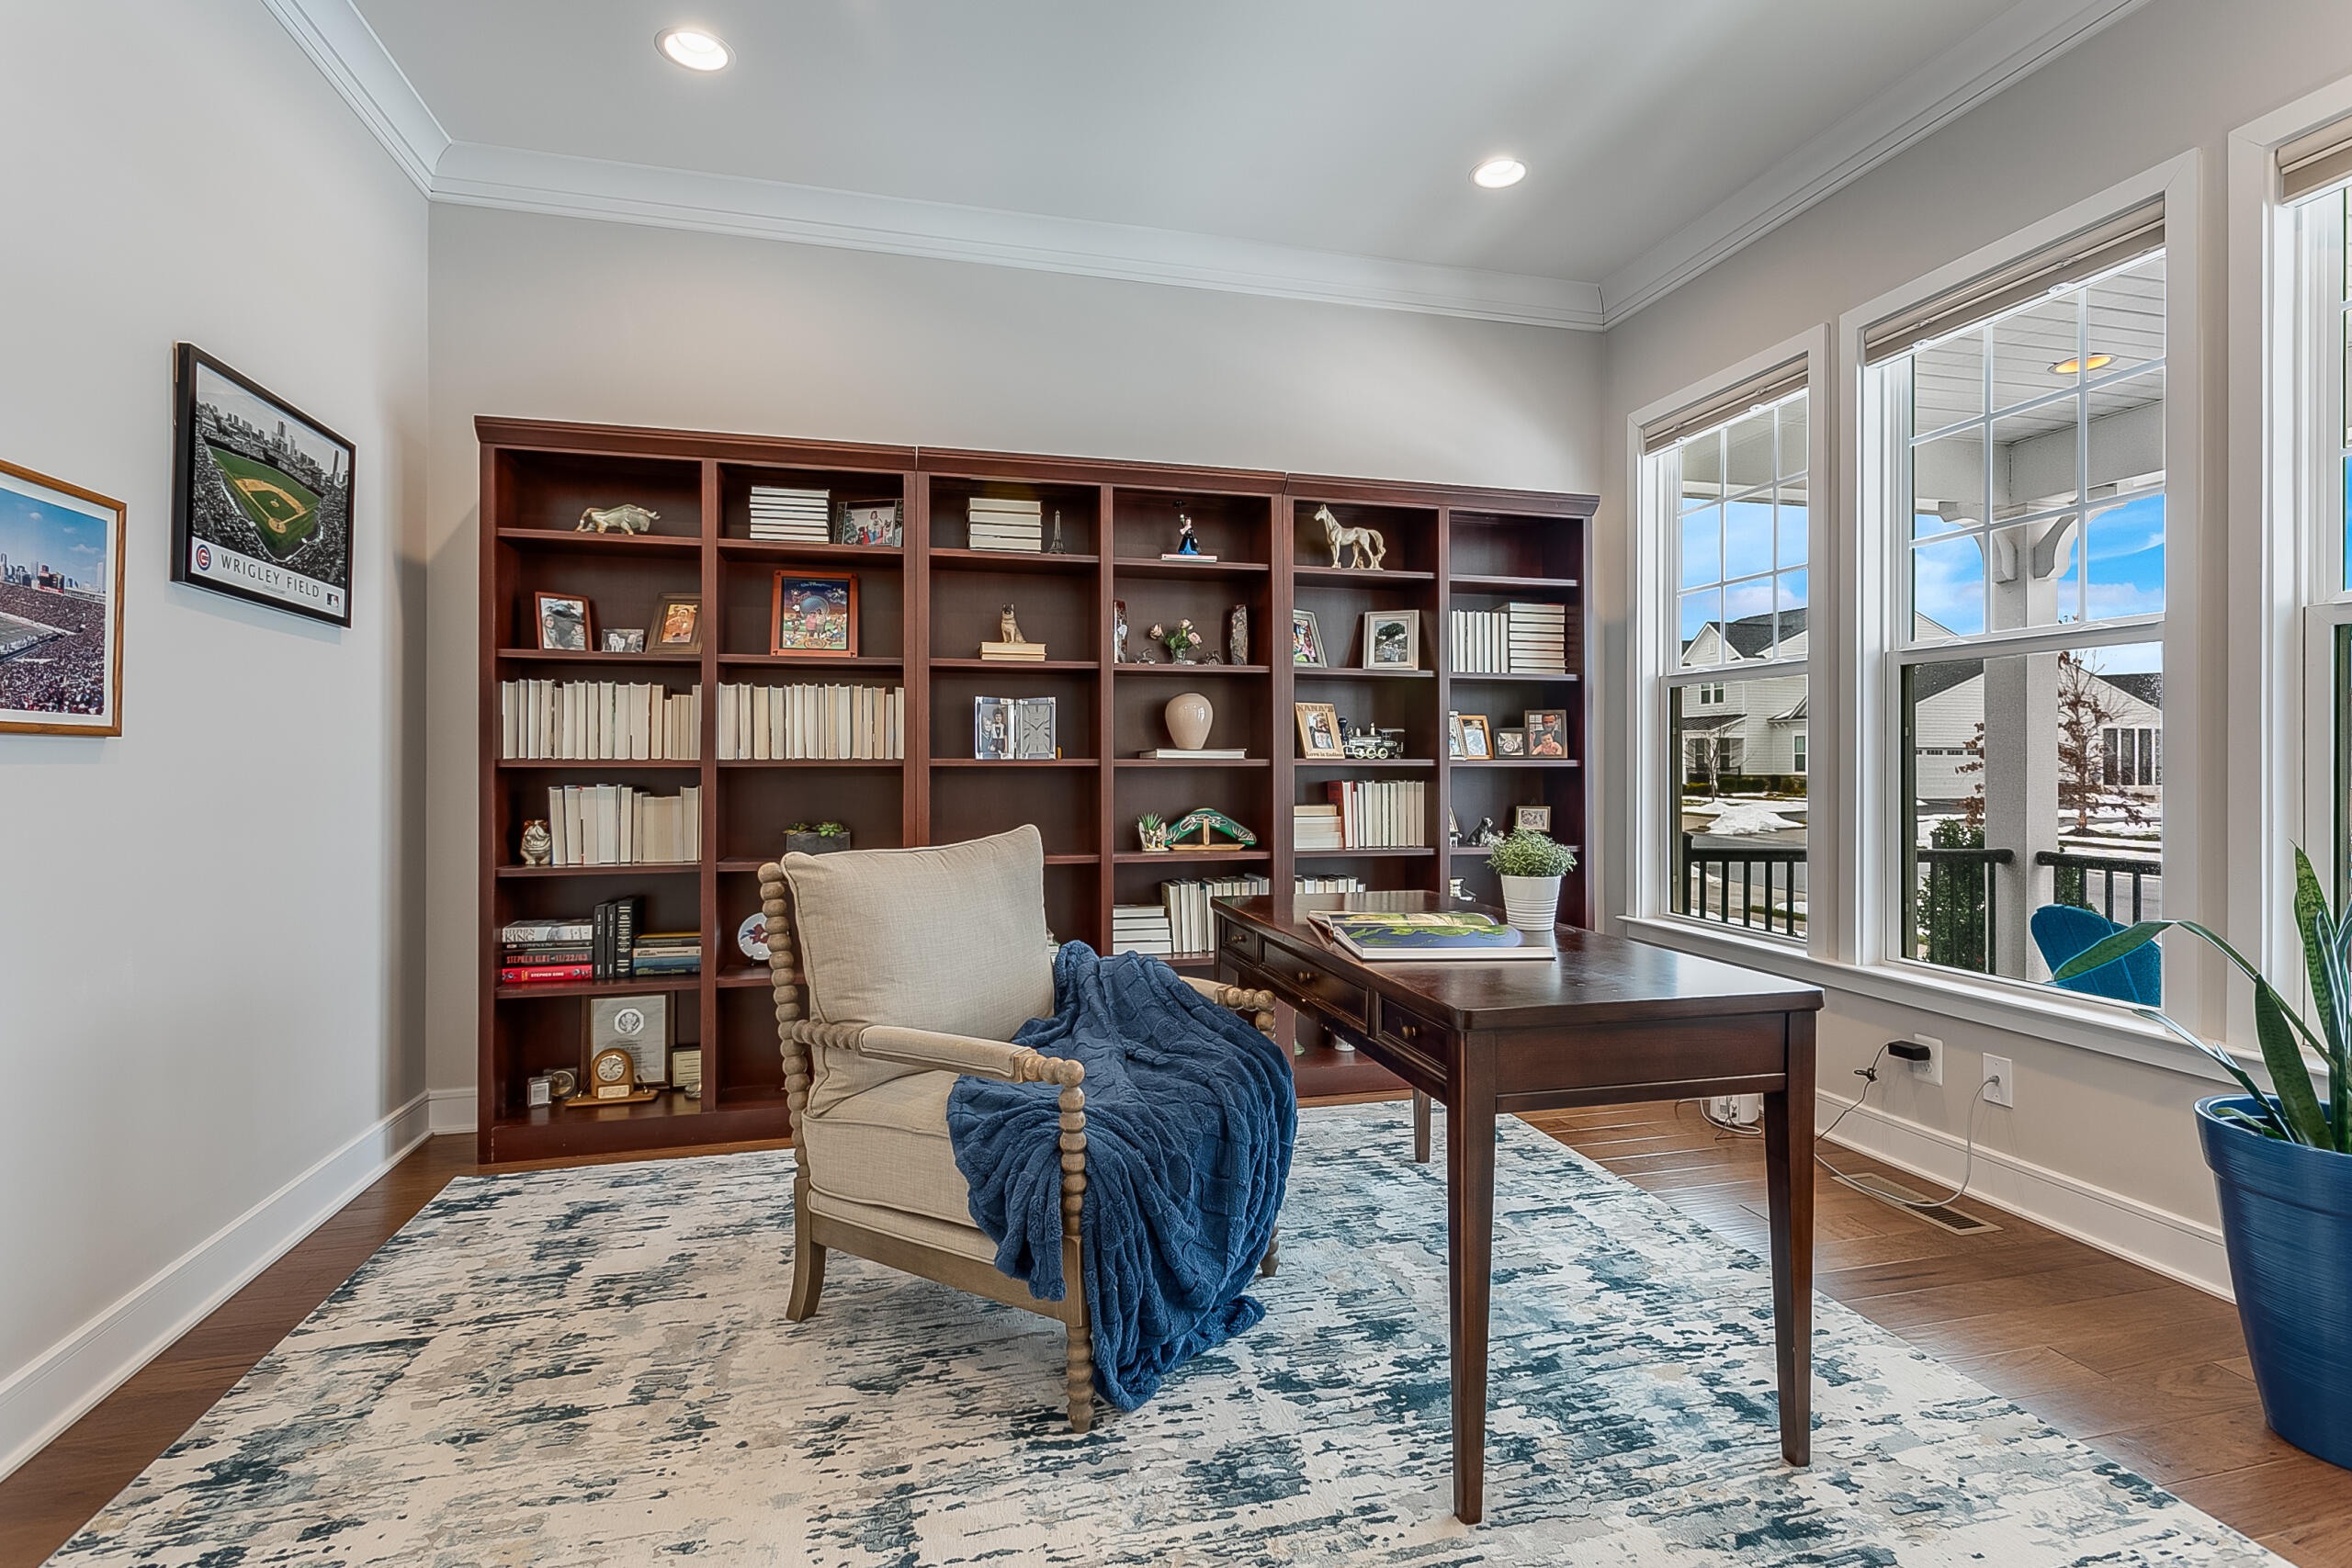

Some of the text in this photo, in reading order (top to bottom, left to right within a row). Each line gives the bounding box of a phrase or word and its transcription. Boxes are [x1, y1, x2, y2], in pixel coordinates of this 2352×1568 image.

[220, 554, 280, 585] WRIGLEY
[287, 576, 320, 598] FIELD
[505, 934, 535, 942] KING
[506, 955, 533, 964] STEPHEN
